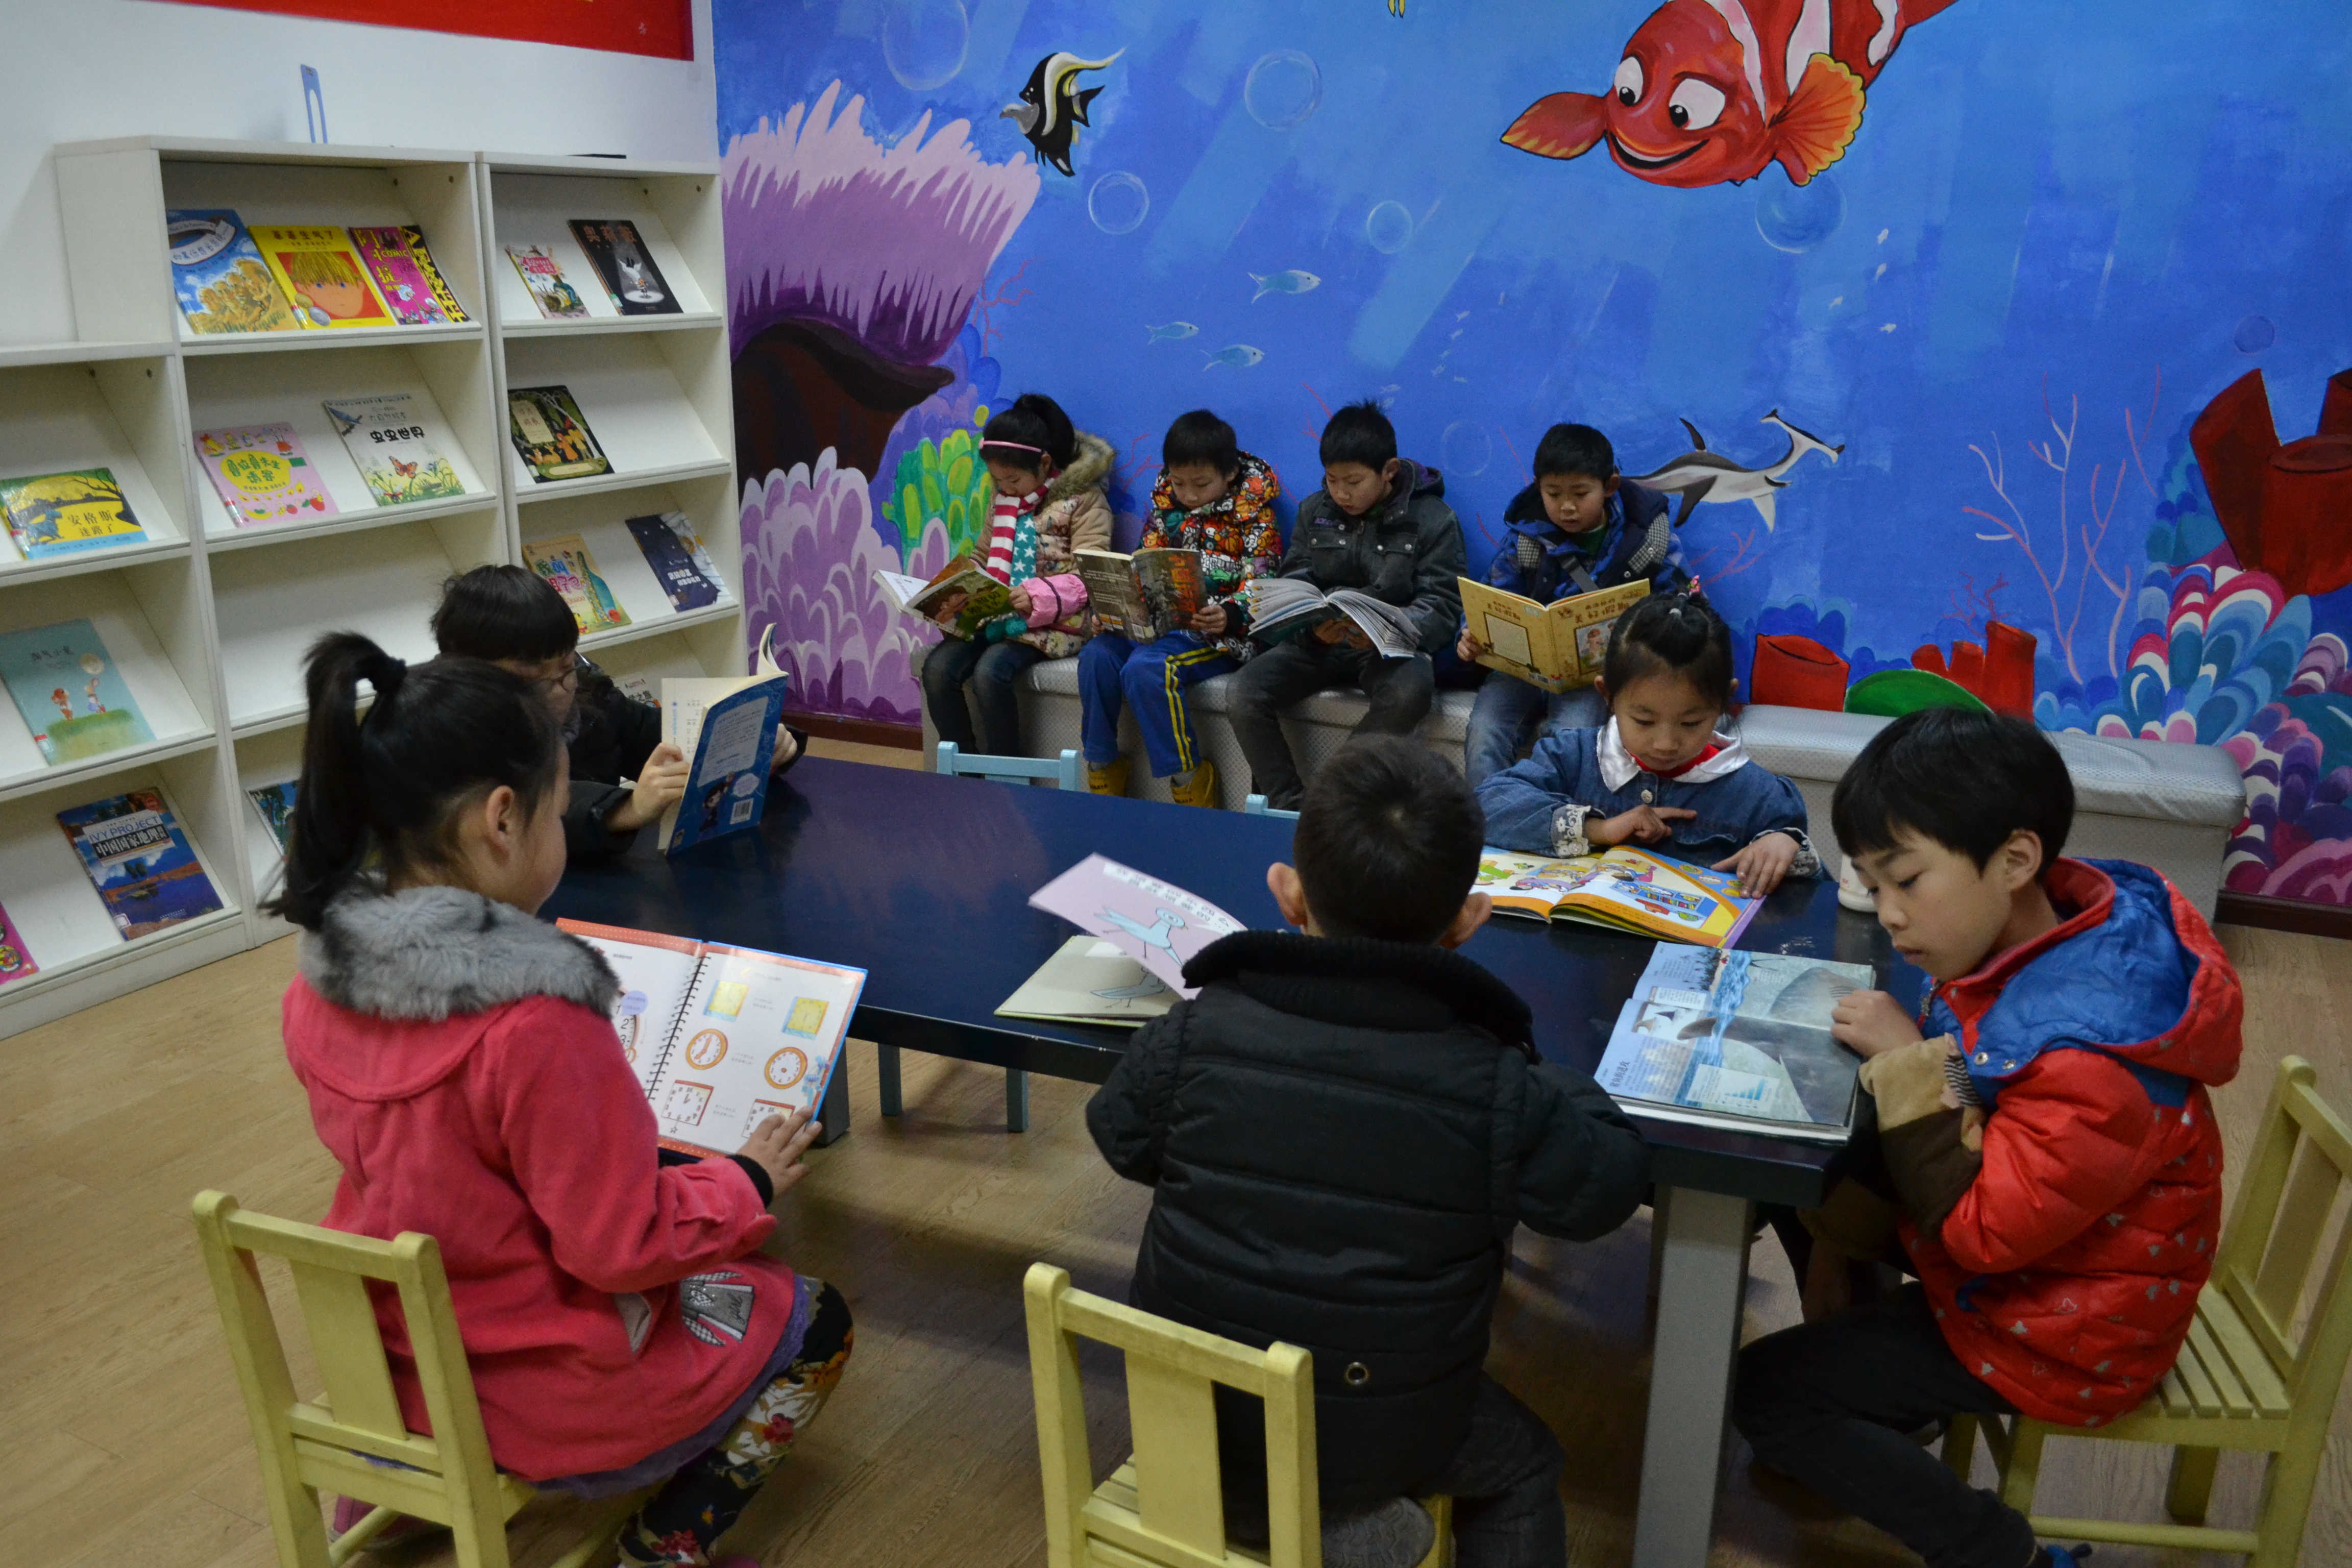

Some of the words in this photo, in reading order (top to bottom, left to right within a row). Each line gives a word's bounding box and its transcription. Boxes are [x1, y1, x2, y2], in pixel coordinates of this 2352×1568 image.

[381, 249, 409, 257] COMIC
[370, 426, 425, 444] 虫虫世界
[68, 510, 113, 526] 安格斯
[88, 830, 108, 843] IVY
[110, 816, 159, 837] PROJECT
[621, 1018, 629, 1030] 2
